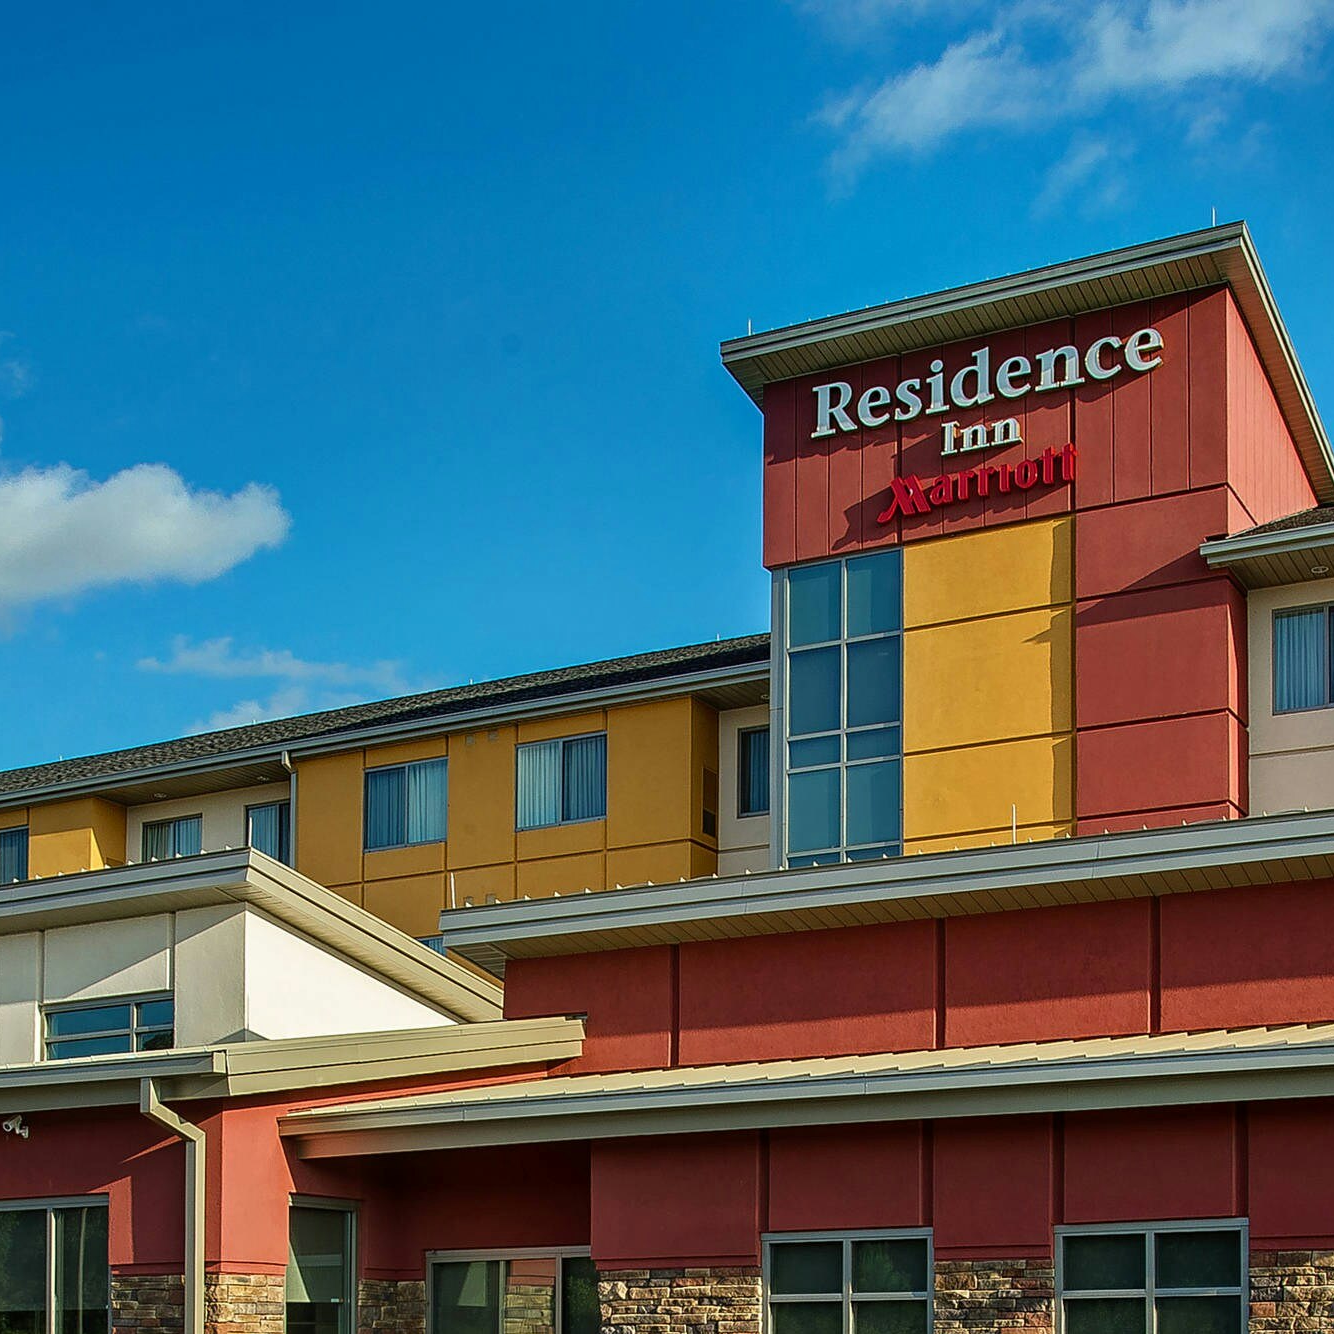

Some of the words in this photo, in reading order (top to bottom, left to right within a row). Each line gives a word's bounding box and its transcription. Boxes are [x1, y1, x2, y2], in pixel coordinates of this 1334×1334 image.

[811, 328, 1164, 440] Residence
[940, 416, 1024, 456] Inn
[877, 442, 1078, 524] Marriott
